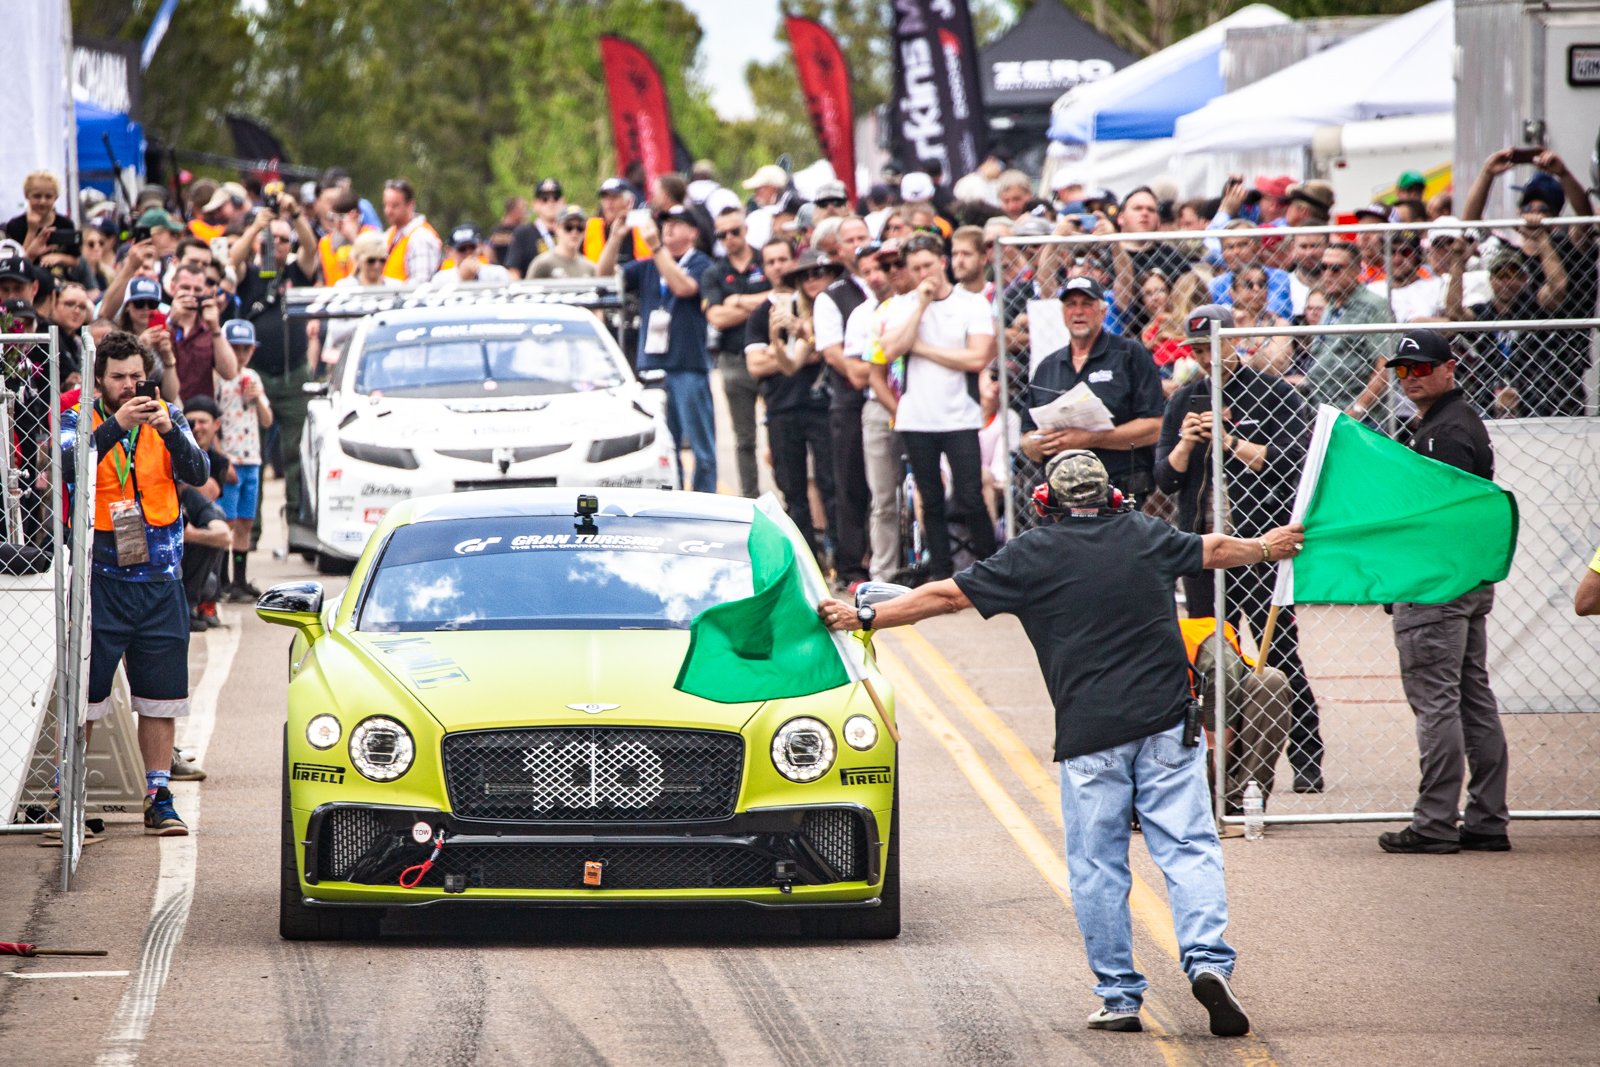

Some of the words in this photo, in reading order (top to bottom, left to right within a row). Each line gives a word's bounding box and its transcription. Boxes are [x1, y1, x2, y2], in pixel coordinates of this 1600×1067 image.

[900, 36, 950, 187] rkins
[511, 534, 571, 546] GRAN
[575, 534, 665, 547] TURISMO
[292, 762, 347, 785] PIRELLI
[522, 741, 665, 813] 10
[839, 765, 892, 786] PIRELLI
